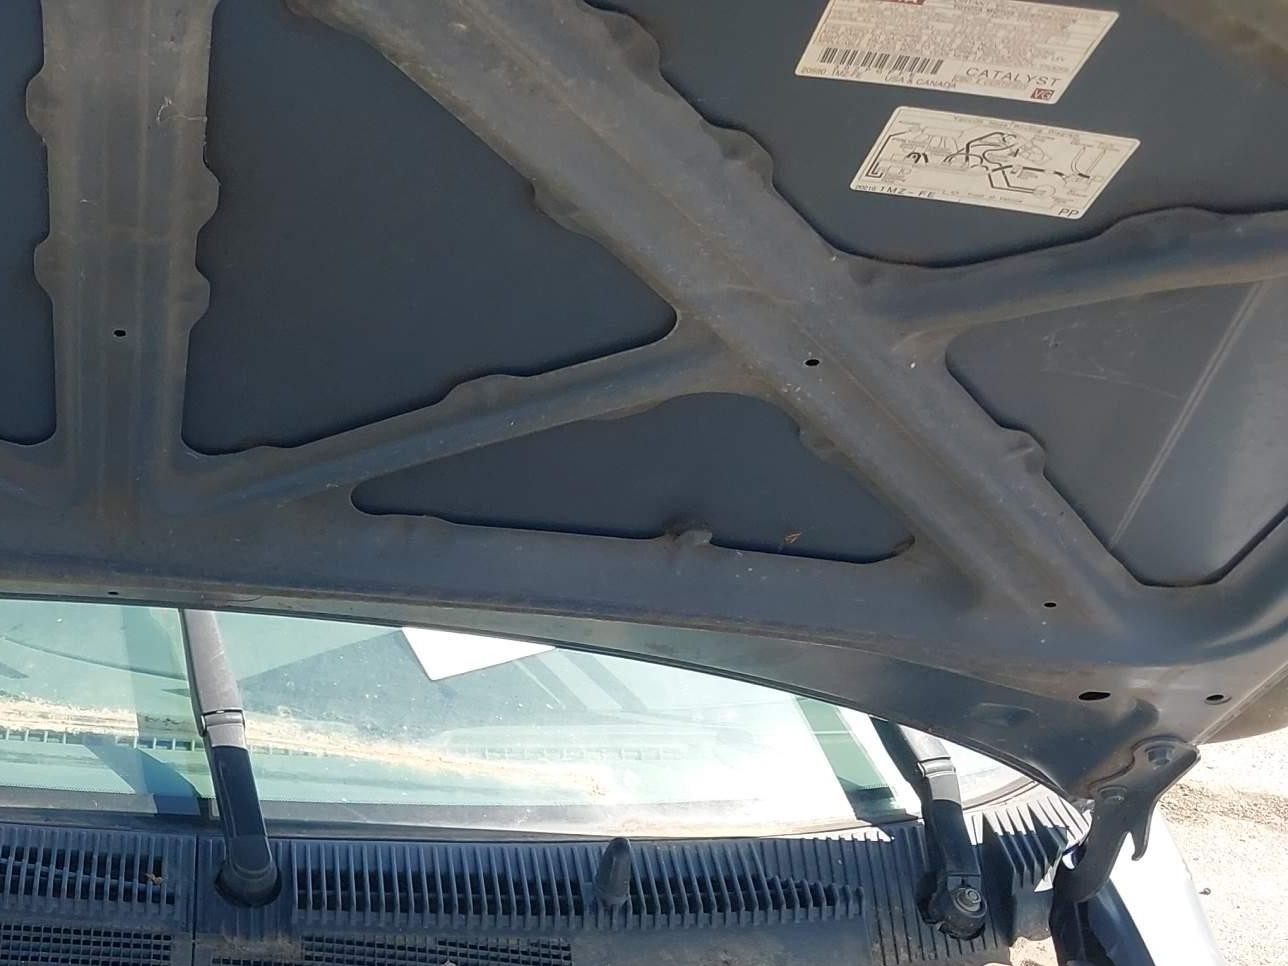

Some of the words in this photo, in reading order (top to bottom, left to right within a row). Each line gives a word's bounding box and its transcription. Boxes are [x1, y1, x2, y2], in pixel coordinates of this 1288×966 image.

[884, 73, 905, 84] USA
[916, 77, 957, 89] CANADA
[965, 67, 1062, 88] CATALYST
[1033, 88, 1053, 101] VG
[1058, 207, 1080, 218] PP
